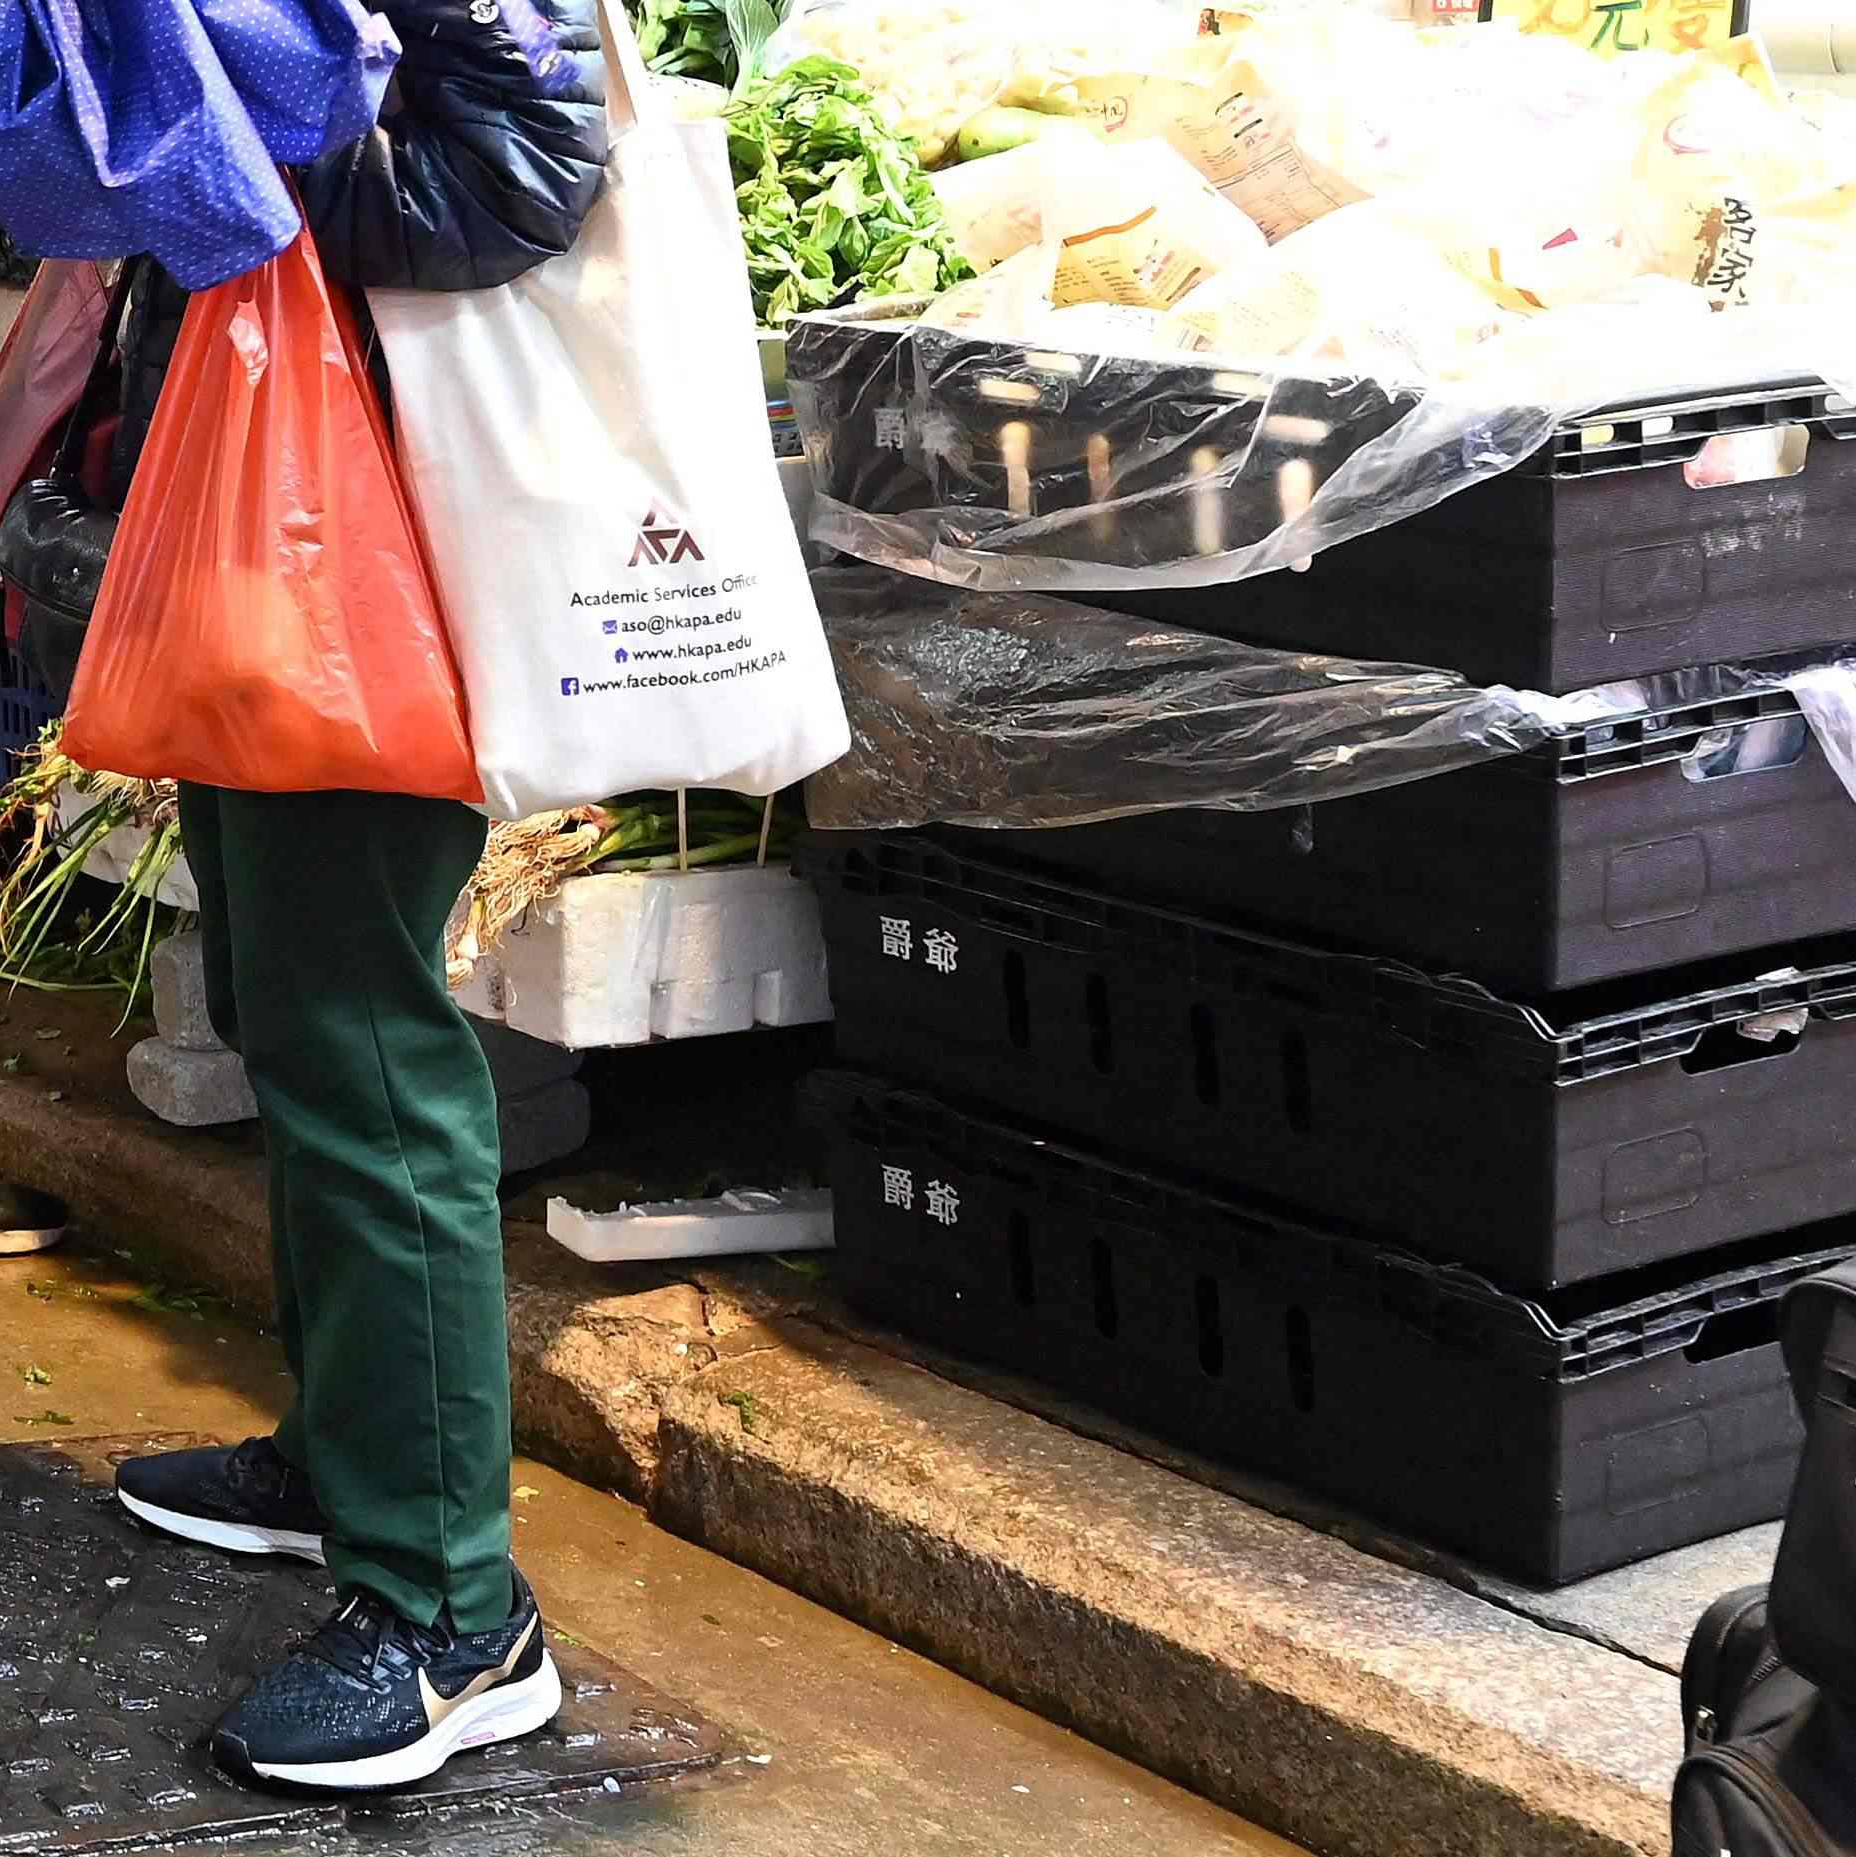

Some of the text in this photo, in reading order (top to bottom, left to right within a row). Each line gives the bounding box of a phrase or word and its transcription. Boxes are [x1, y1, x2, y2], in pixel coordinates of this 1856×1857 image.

[570, 574, 758, 607] Academic Services Office
[621, 607, 743, 635] aso@hkapa.edu
[632, 634, 753, 661] www.hkapa.edu
[583, 649, 788, 694] www.facebook.com/HKAPA
